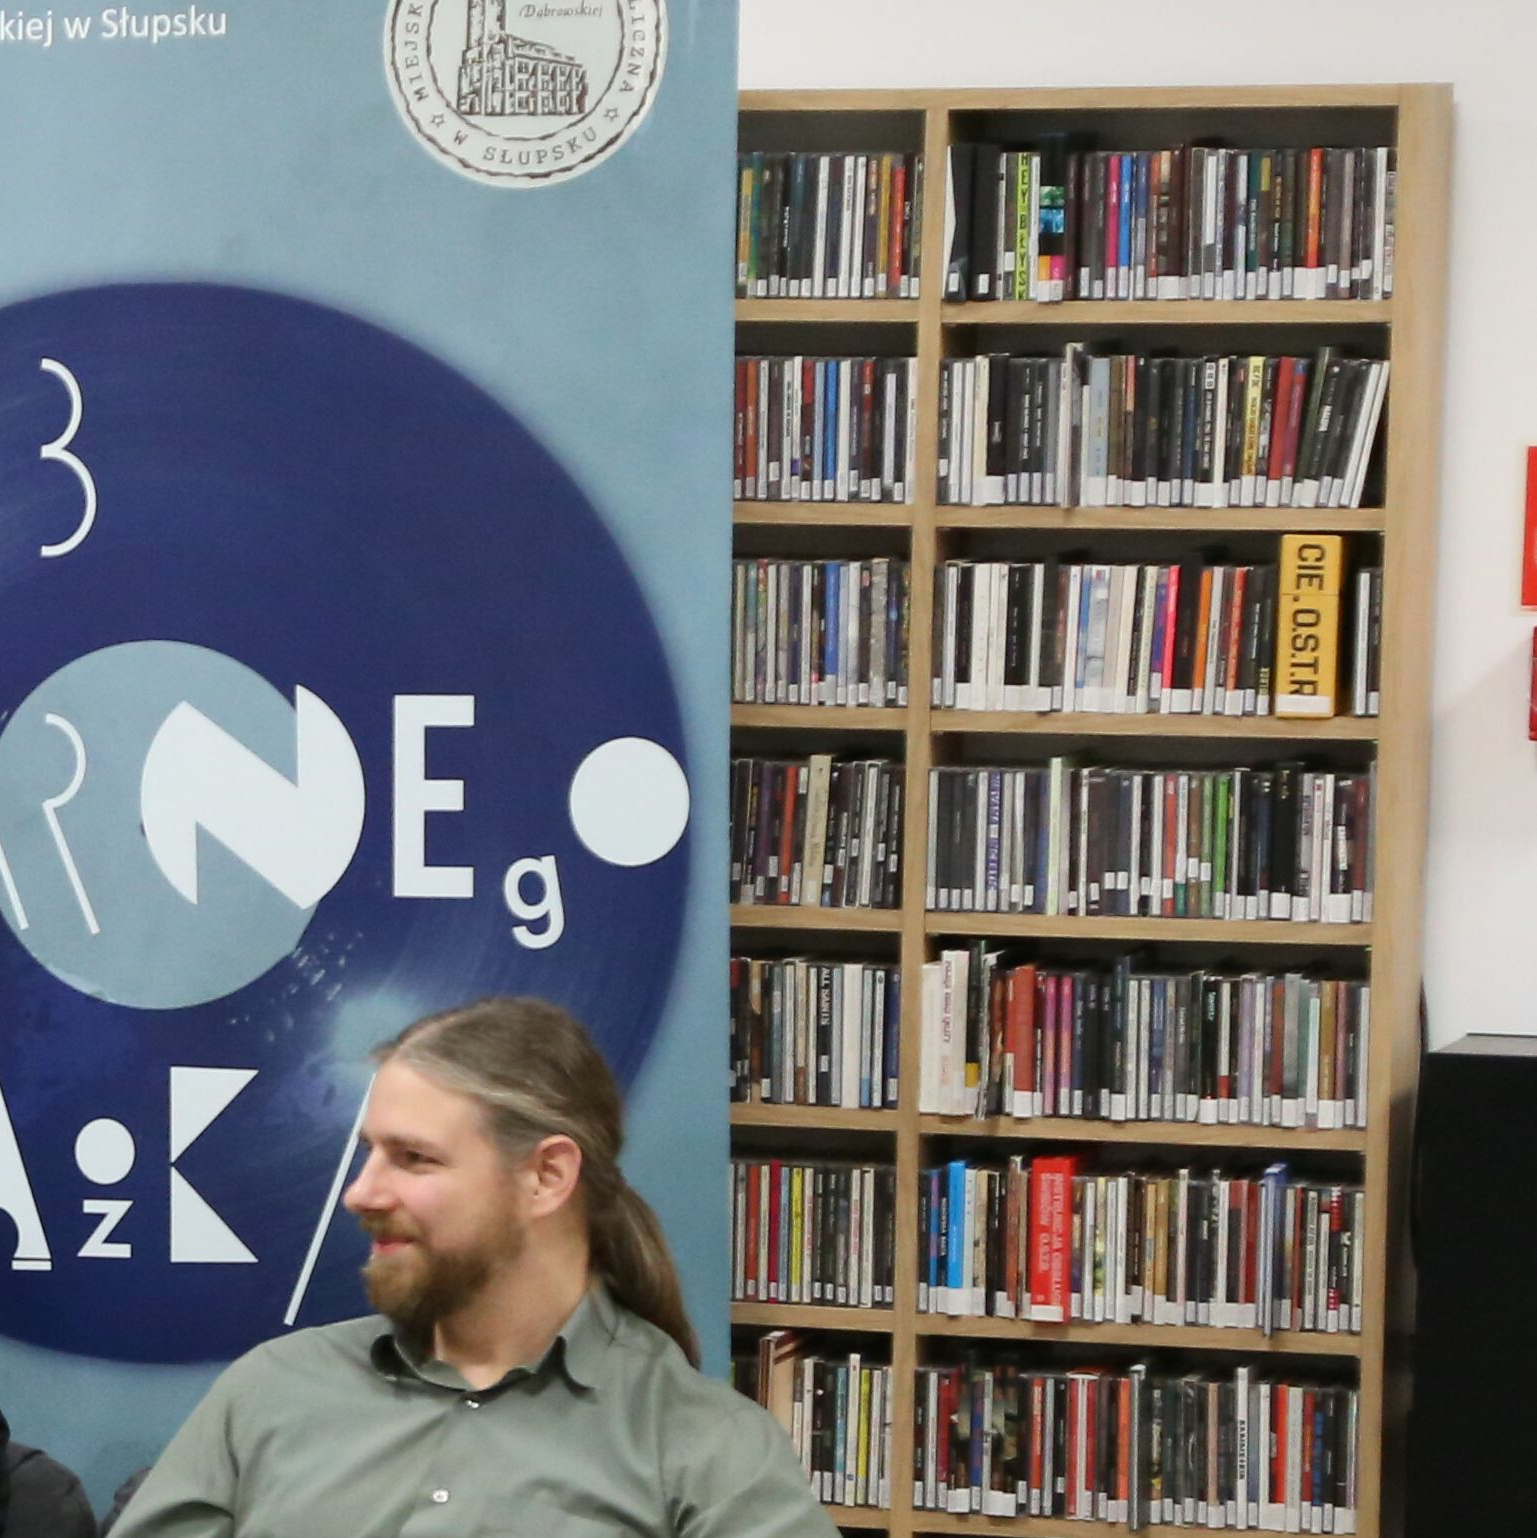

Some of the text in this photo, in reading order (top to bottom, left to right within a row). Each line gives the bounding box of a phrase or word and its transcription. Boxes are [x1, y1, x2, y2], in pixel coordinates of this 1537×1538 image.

[62, 16, 92, 41] w
[101, 4, 227, 44] Słupsku
[482, 126, 598, 166] SŁUPSKU
[820, 968, 831, 1026] ALL SAINTS
